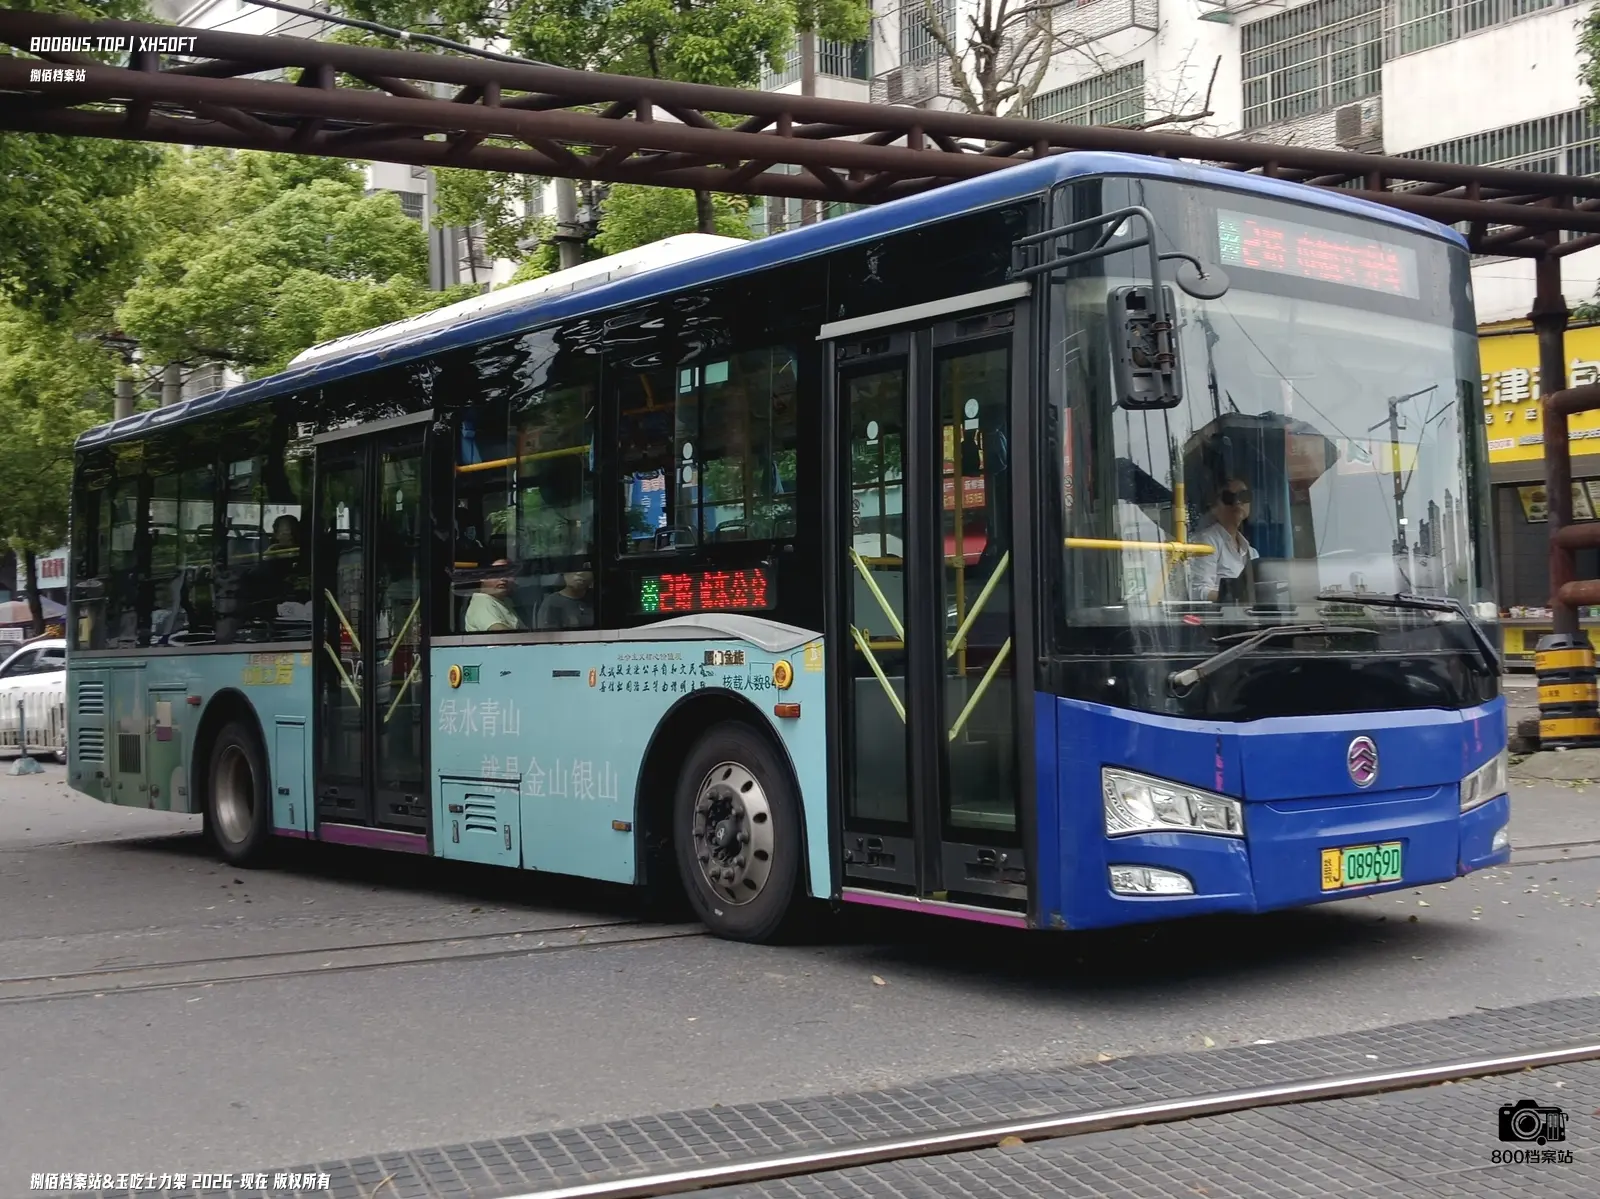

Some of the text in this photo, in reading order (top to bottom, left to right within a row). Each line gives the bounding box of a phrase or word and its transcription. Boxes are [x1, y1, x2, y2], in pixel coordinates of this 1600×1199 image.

[438, 698, 521, 737] 绿水青山
[481, 756, 619, 802] 就是金山银山
